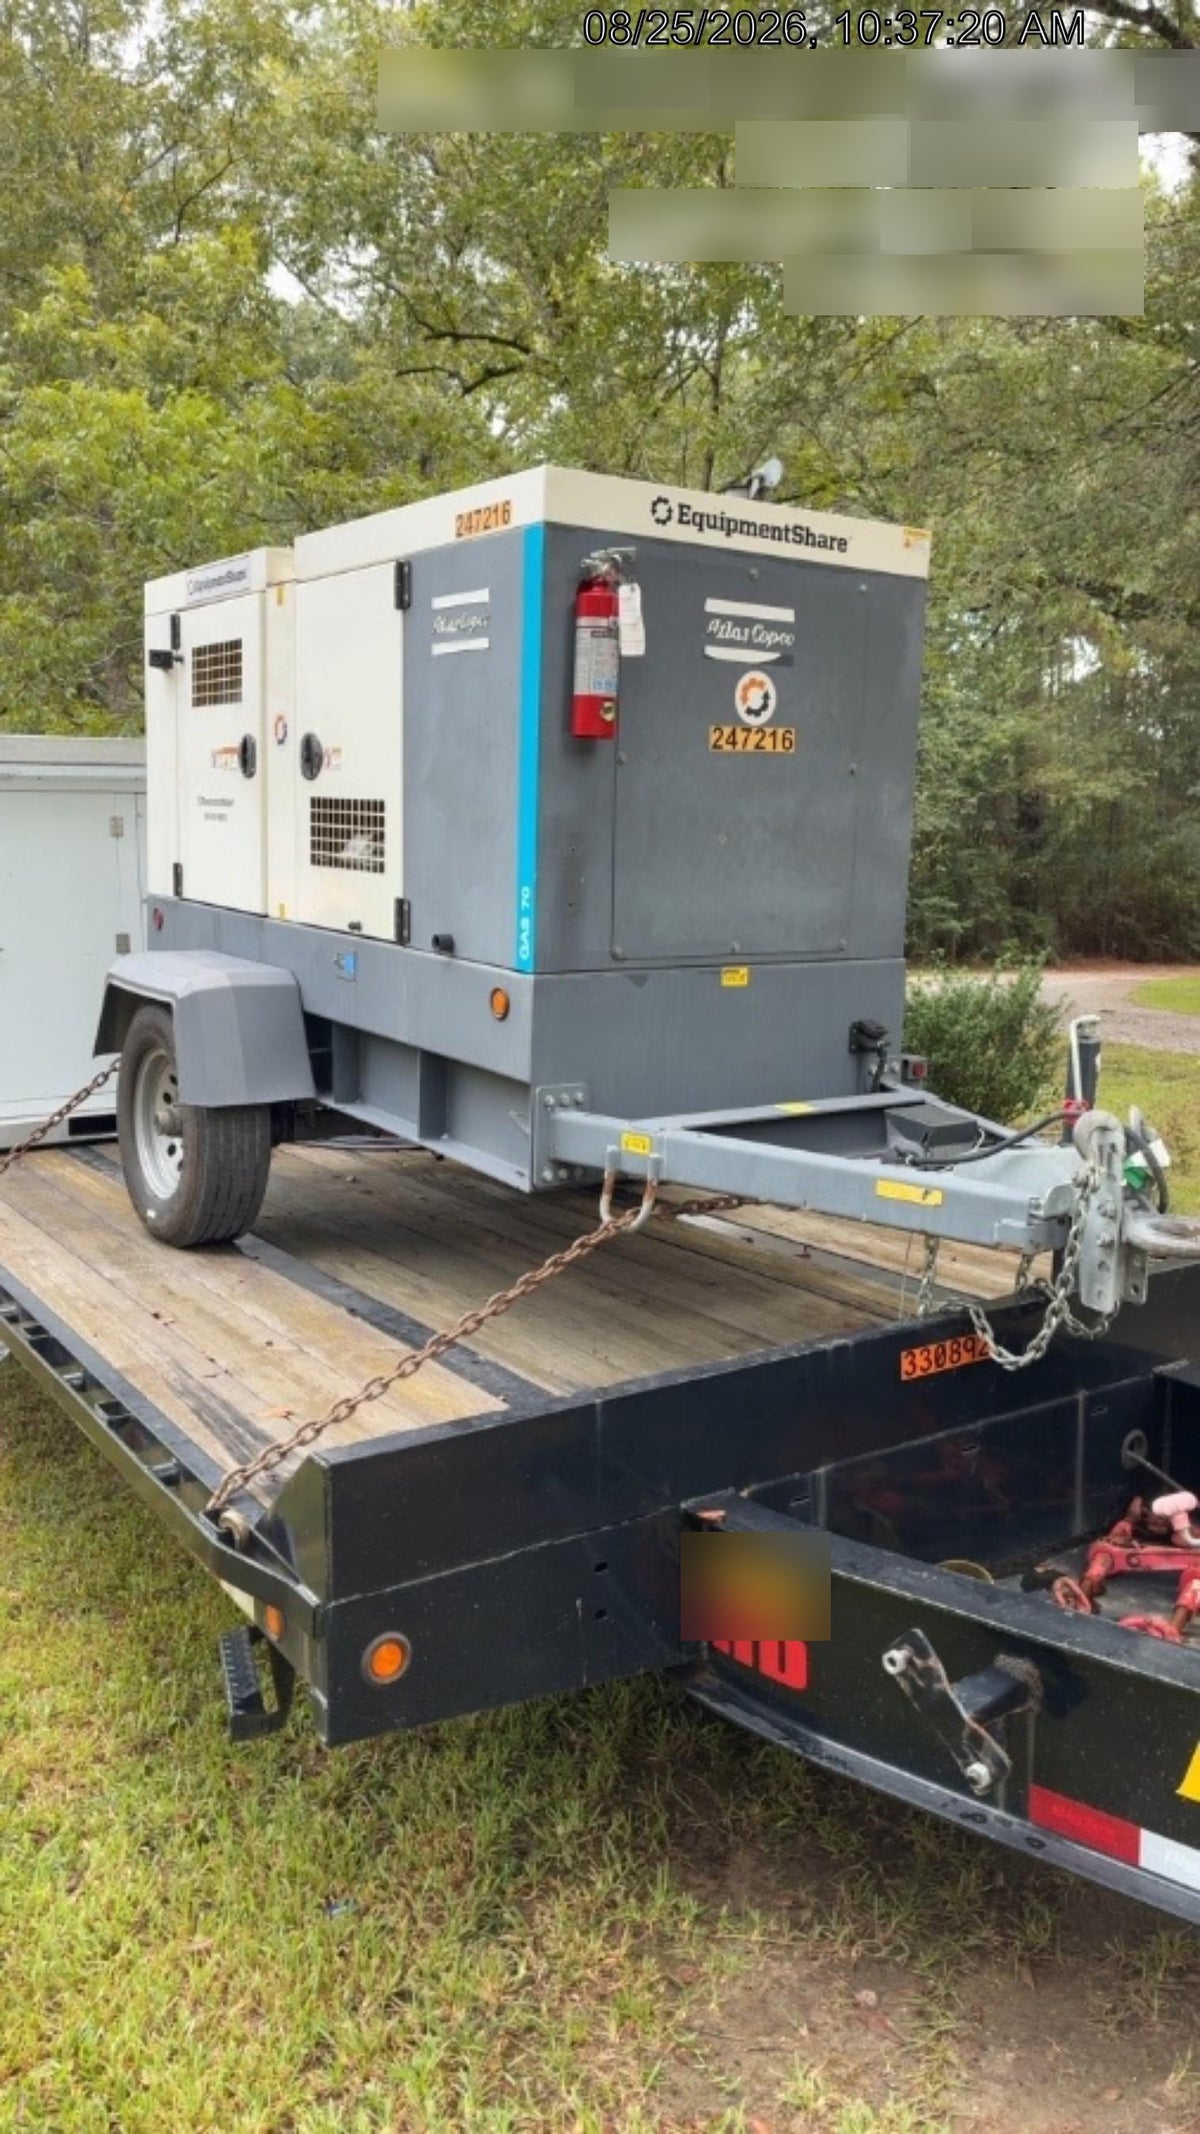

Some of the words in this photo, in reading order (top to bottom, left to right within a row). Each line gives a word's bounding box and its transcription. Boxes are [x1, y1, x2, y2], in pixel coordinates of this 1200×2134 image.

[455, 500, 512, 538] 247216
[677, 502, 849, 553] EquipmentShare
[706, 618, 750, 642] Atlas
[751, 623, 796, 648] Copco
[711, 727, 794, 751] 247216
